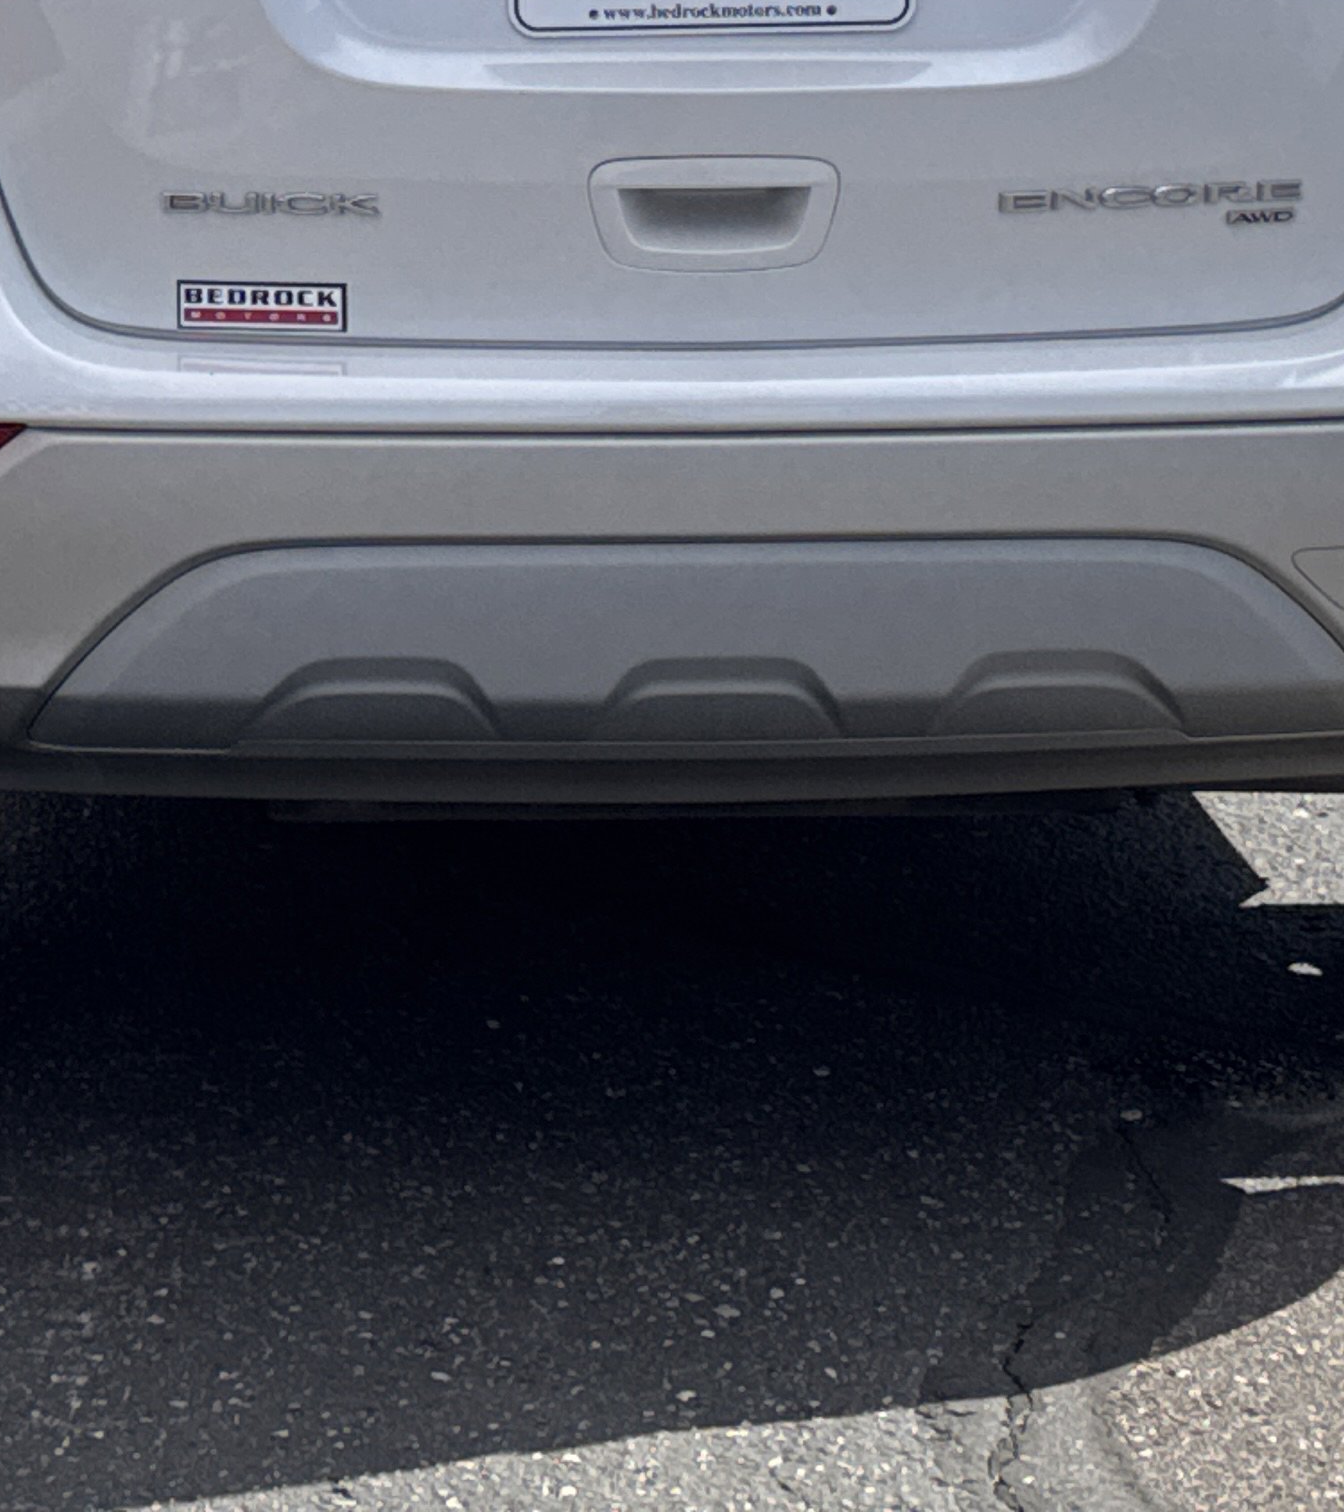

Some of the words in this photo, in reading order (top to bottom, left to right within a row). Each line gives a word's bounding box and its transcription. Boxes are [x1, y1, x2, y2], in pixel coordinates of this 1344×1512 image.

[604, 4, 822, 20] www.bedrockmotors.com
[163, 191, 380, 215] BUICK
[998, 179, 1302, 213] ENCORE
[1225, 207, 1296, 225] AWD
[184, 288, 337, 307] BEDROCK
